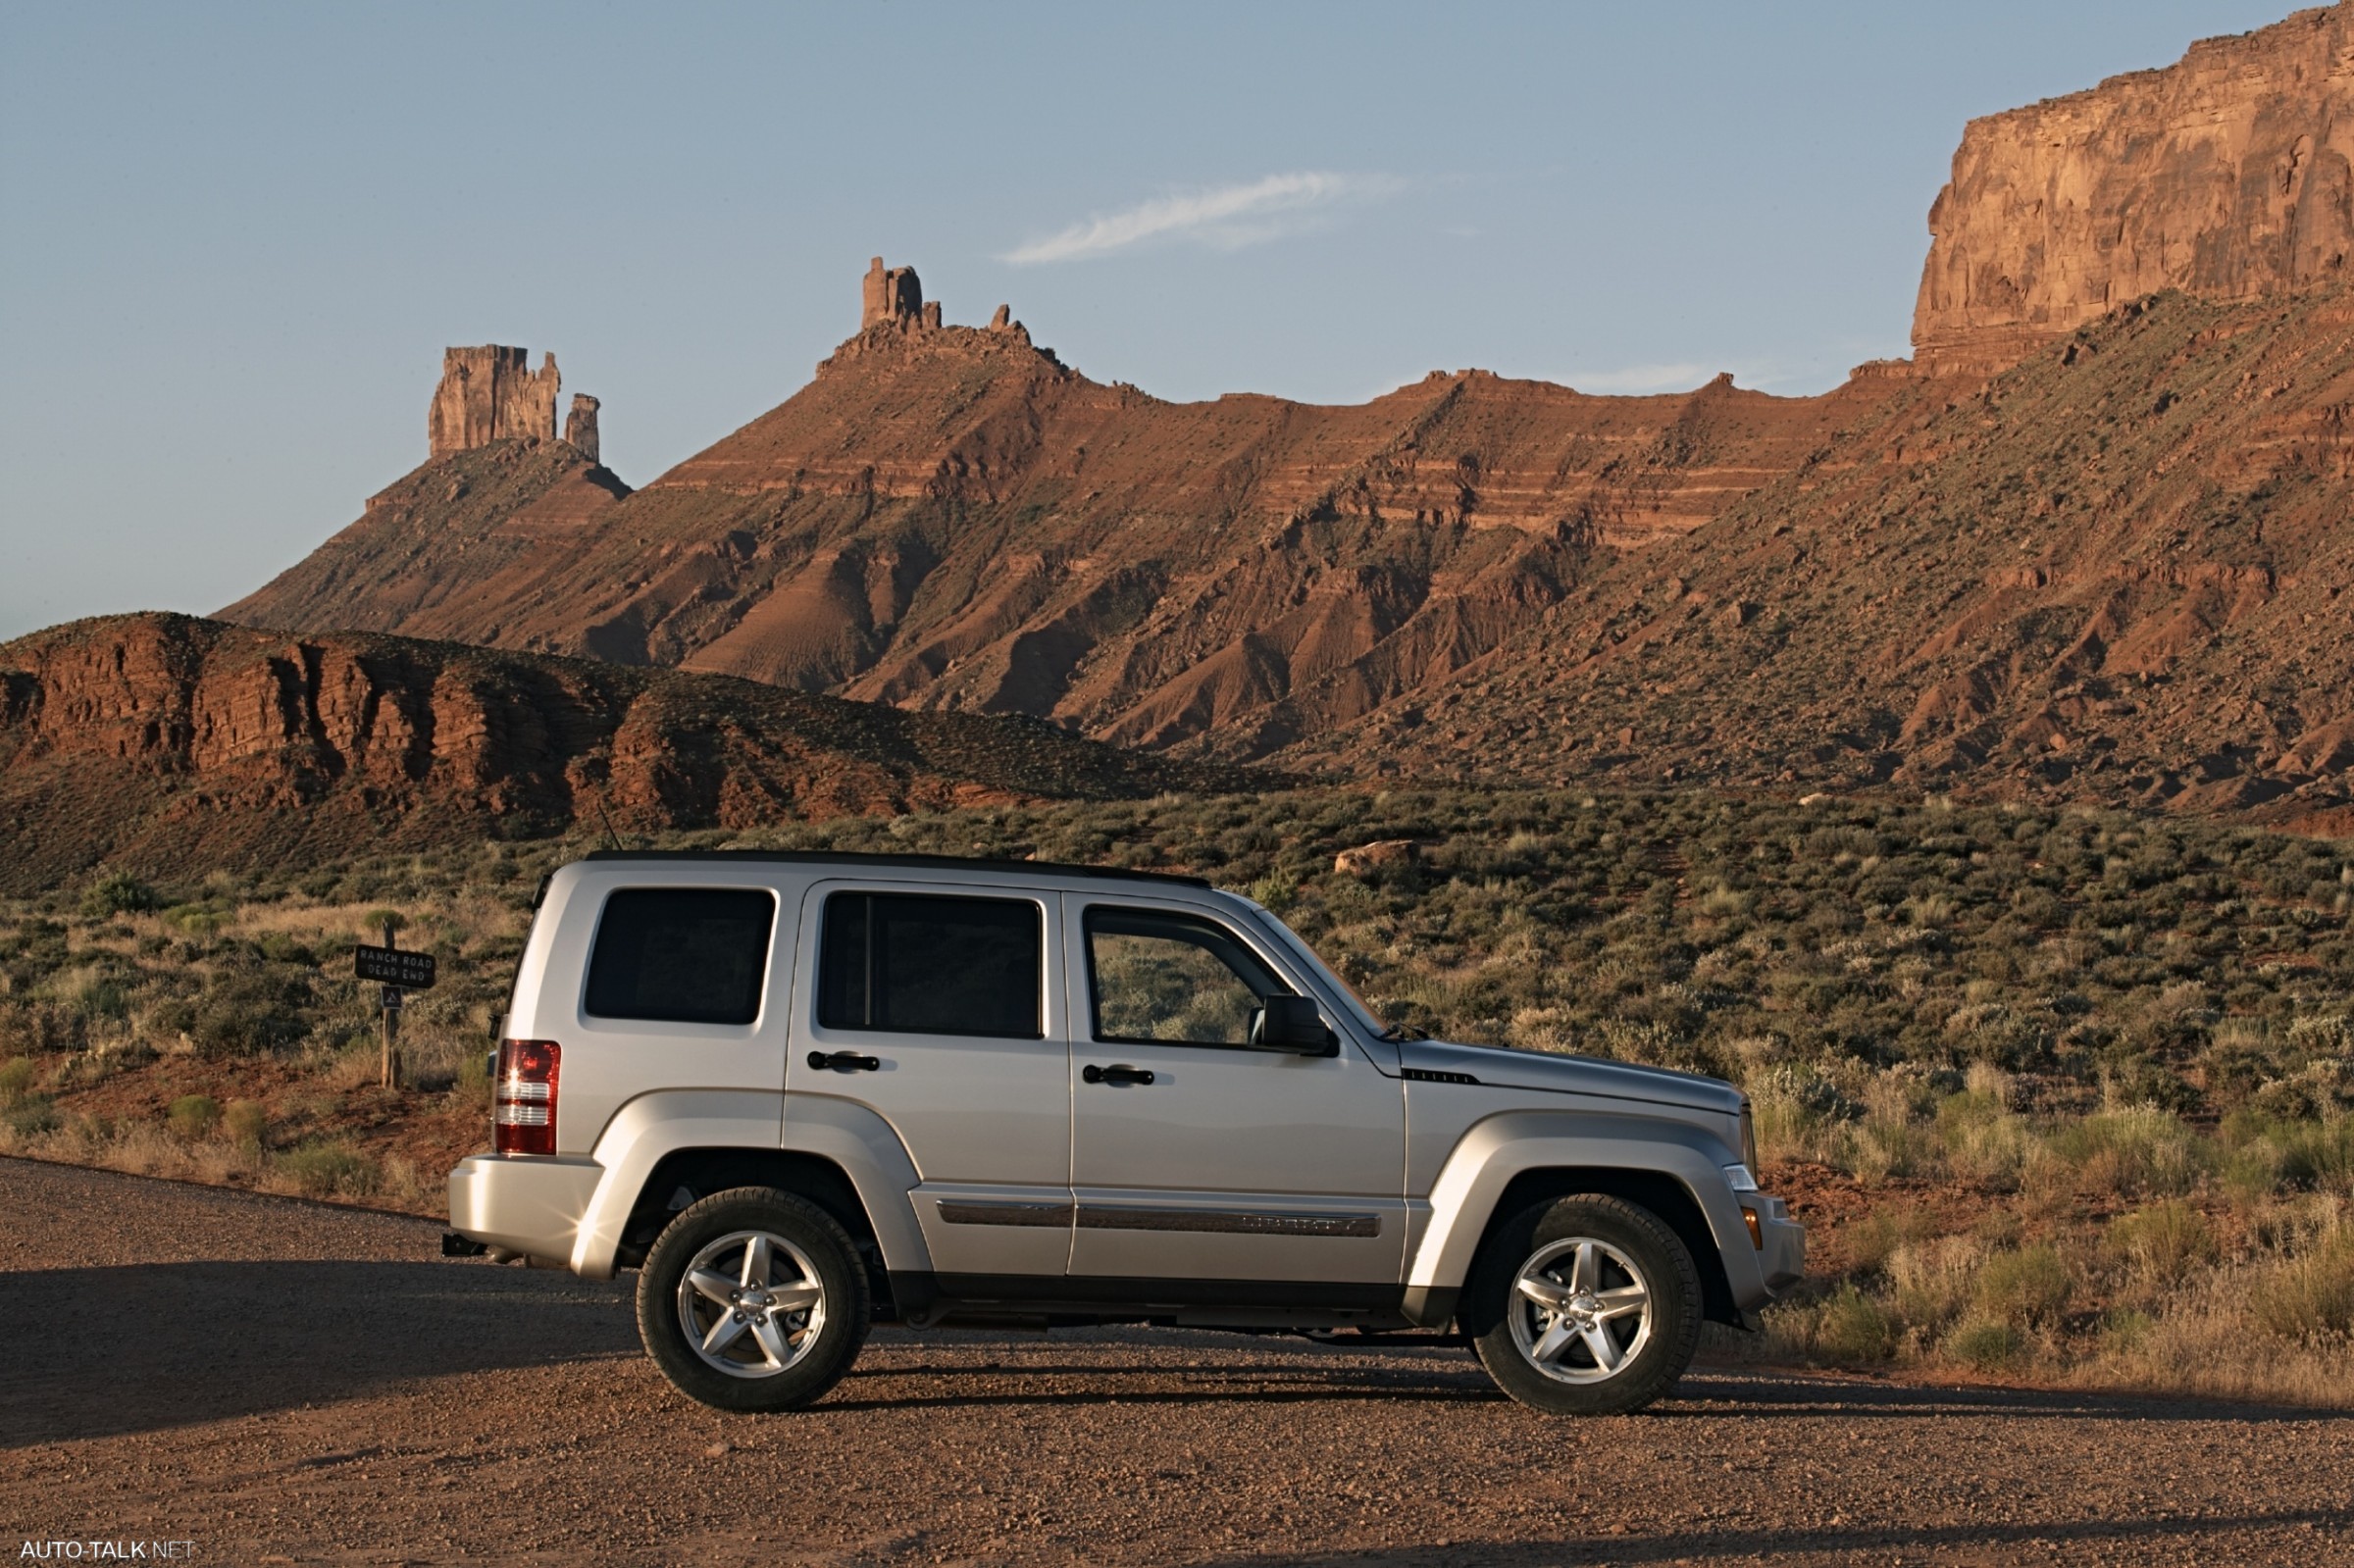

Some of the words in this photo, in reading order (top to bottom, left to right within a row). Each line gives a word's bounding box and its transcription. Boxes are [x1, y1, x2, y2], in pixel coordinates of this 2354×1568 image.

[360, 949, 397, 963] RANCH
[402, 956, 432, 969] ROAD
[368, 964, 397, 977] DEAD
[402, 969, 425, 982] END
